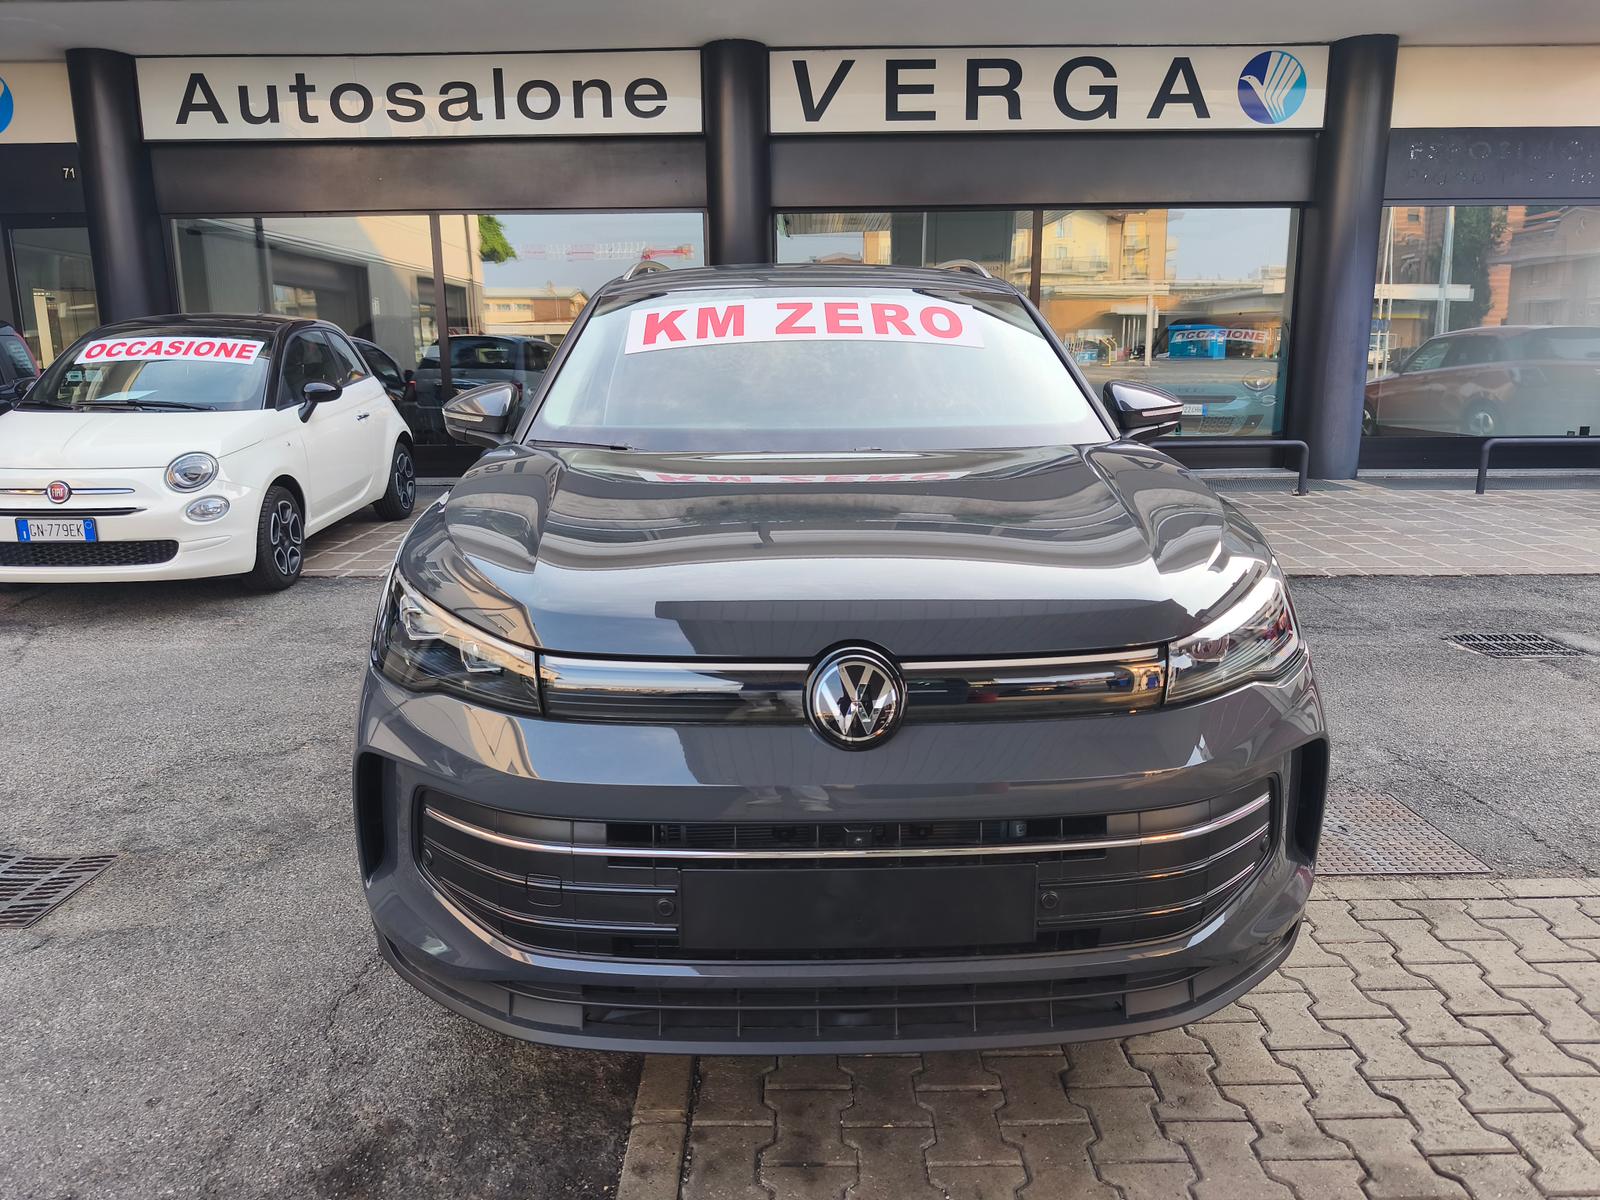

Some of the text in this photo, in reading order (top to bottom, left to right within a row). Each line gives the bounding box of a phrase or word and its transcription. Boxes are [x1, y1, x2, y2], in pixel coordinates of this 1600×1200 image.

[176, 67, 669, 125] Autosalone
[791, 56, 1211, 123] VERGA
[62, 167, 76, 179] 71
[642, 302, 963, 345] KM ZERO
[1175, 330, 1265, 342] OCCASIONE
[84, 340, 257, 360] OCCASIONE
[51, 487, 64, 498] FIAT
